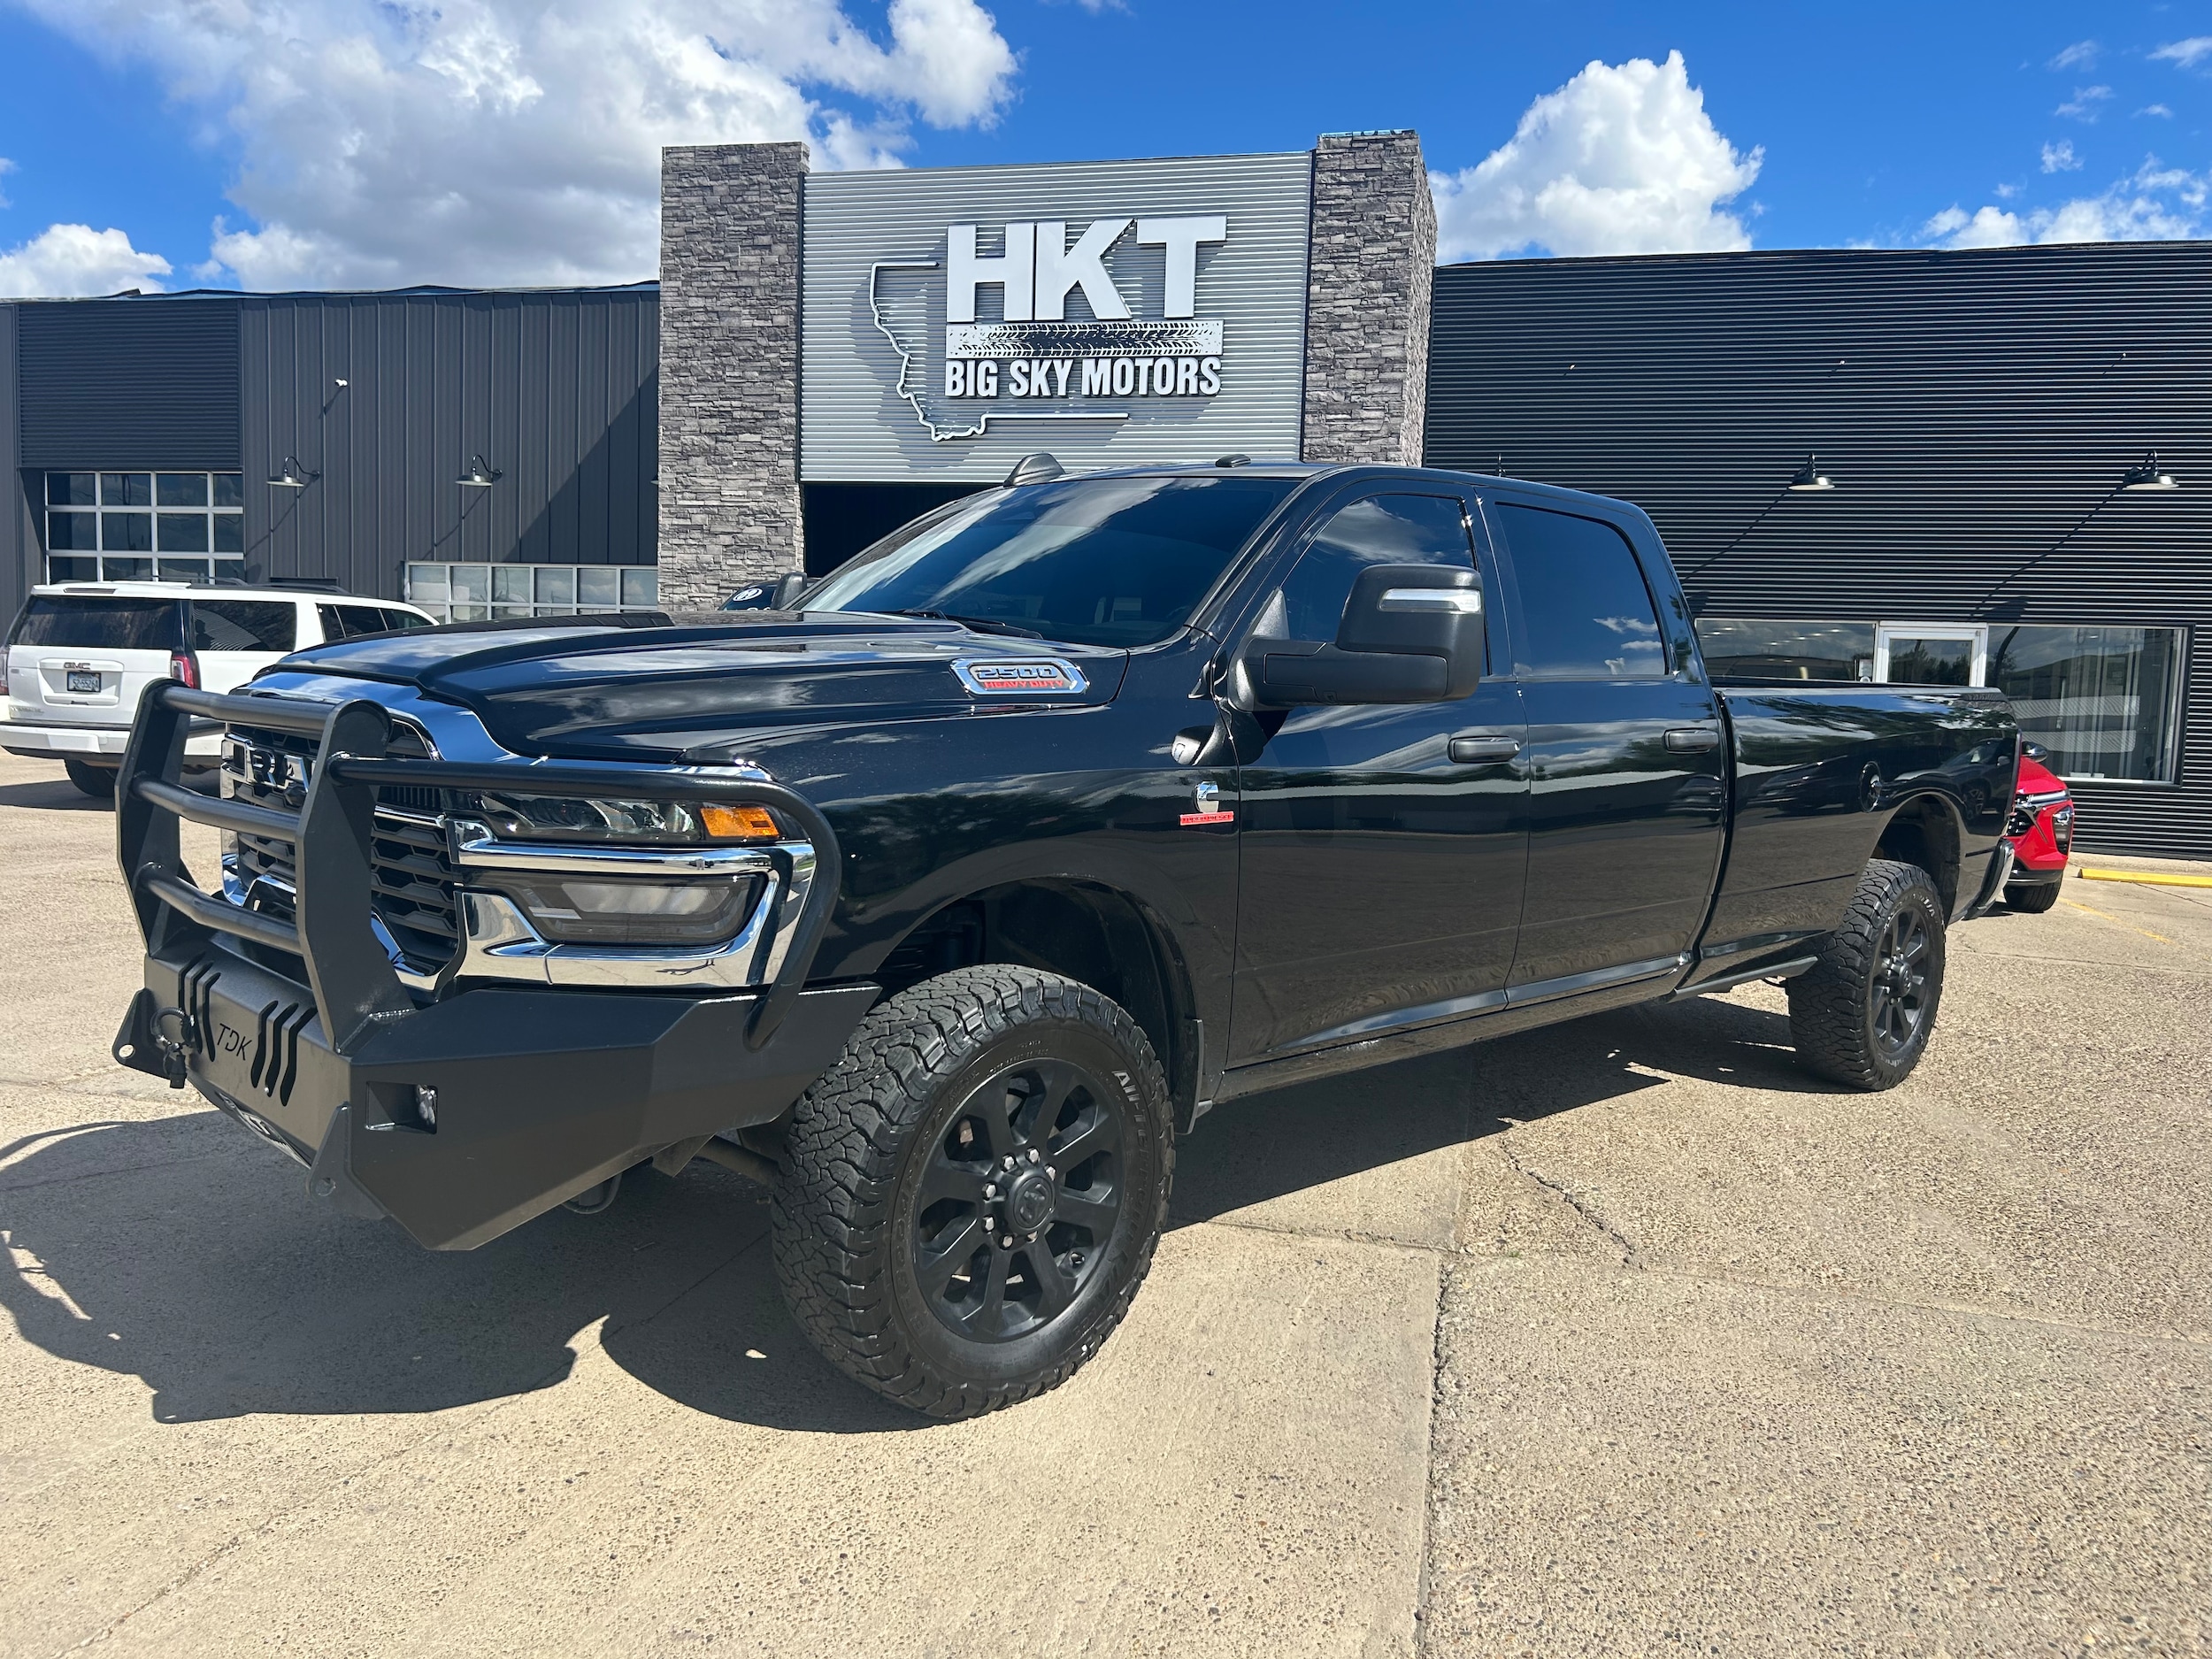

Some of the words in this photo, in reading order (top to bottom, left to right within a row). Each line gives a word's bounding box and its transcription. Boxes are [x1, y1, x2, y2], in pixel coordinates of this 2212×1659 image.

[946, 215, 1228, 323] HKT
[944, 358, 998, 397] BIG
[1009, 358, 1072, 397] SKY
[1081, 357, 1222, 396] MOTORS
[975, 667, 1057, 680] 2500
[217, 1023, 253, 1061] TDK
